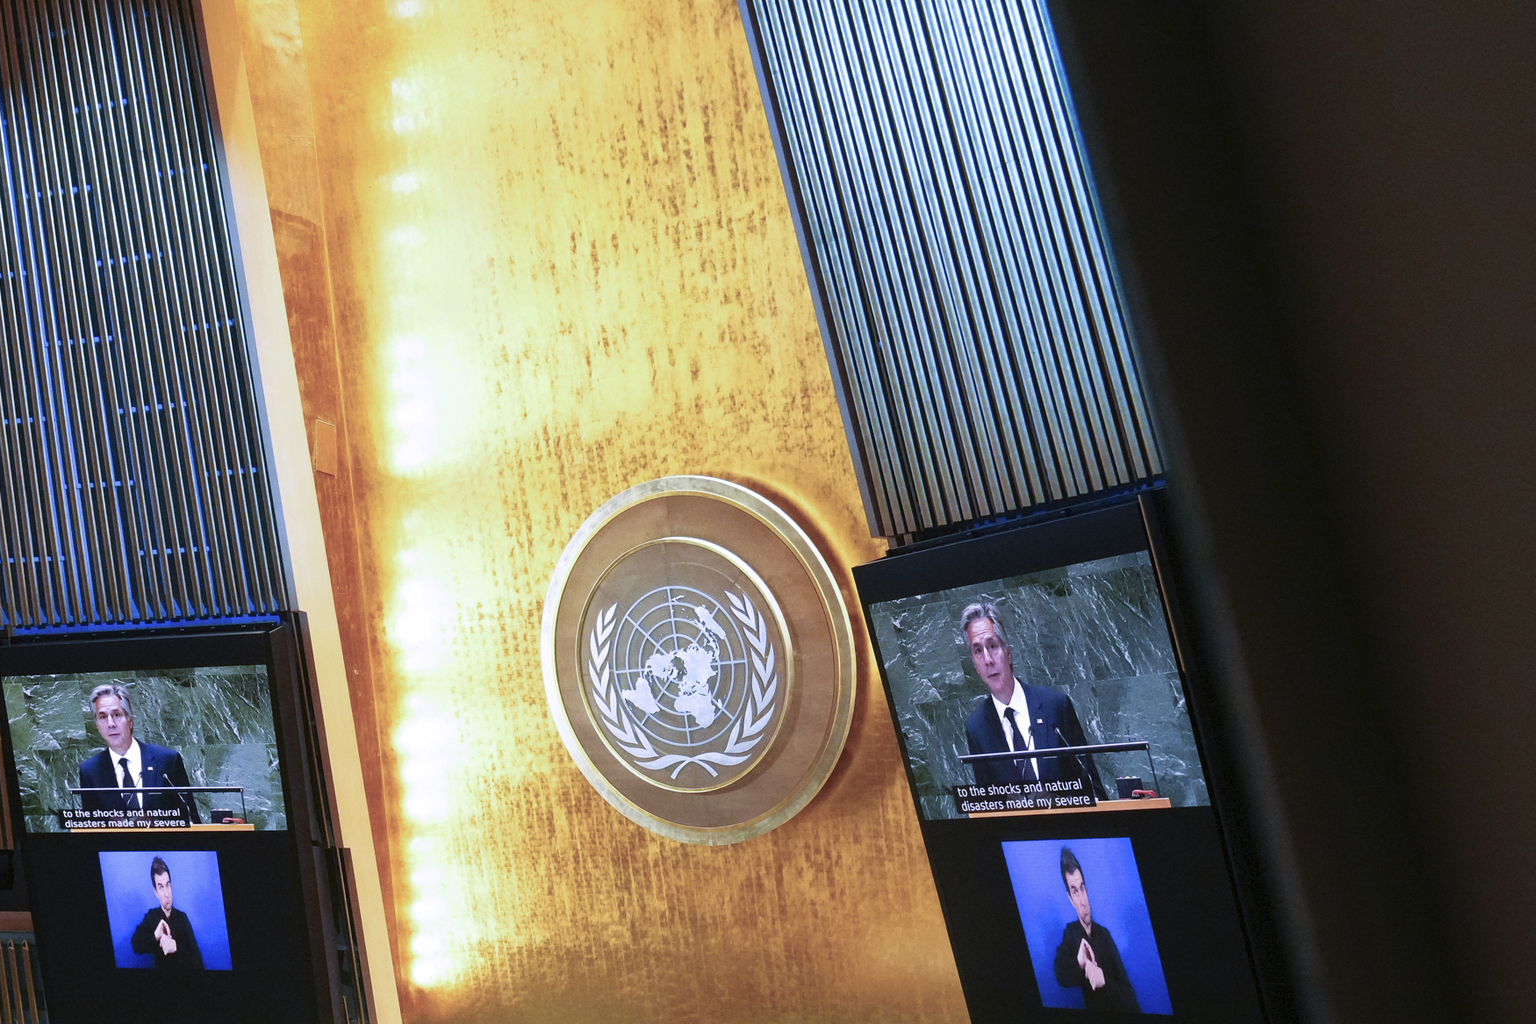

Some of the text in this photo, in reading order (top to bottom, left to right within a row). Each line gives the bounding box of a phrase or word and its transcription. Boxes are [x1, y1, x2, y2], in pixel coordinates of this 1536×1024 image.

[957, 778, 1083, 798] to the shocks and natural
[961, 795, 1091, 812] disasters made my severe
[63, 808, 181, 818] to the shocks and natural
[64, 819, 186, 829] disasters made my severe
